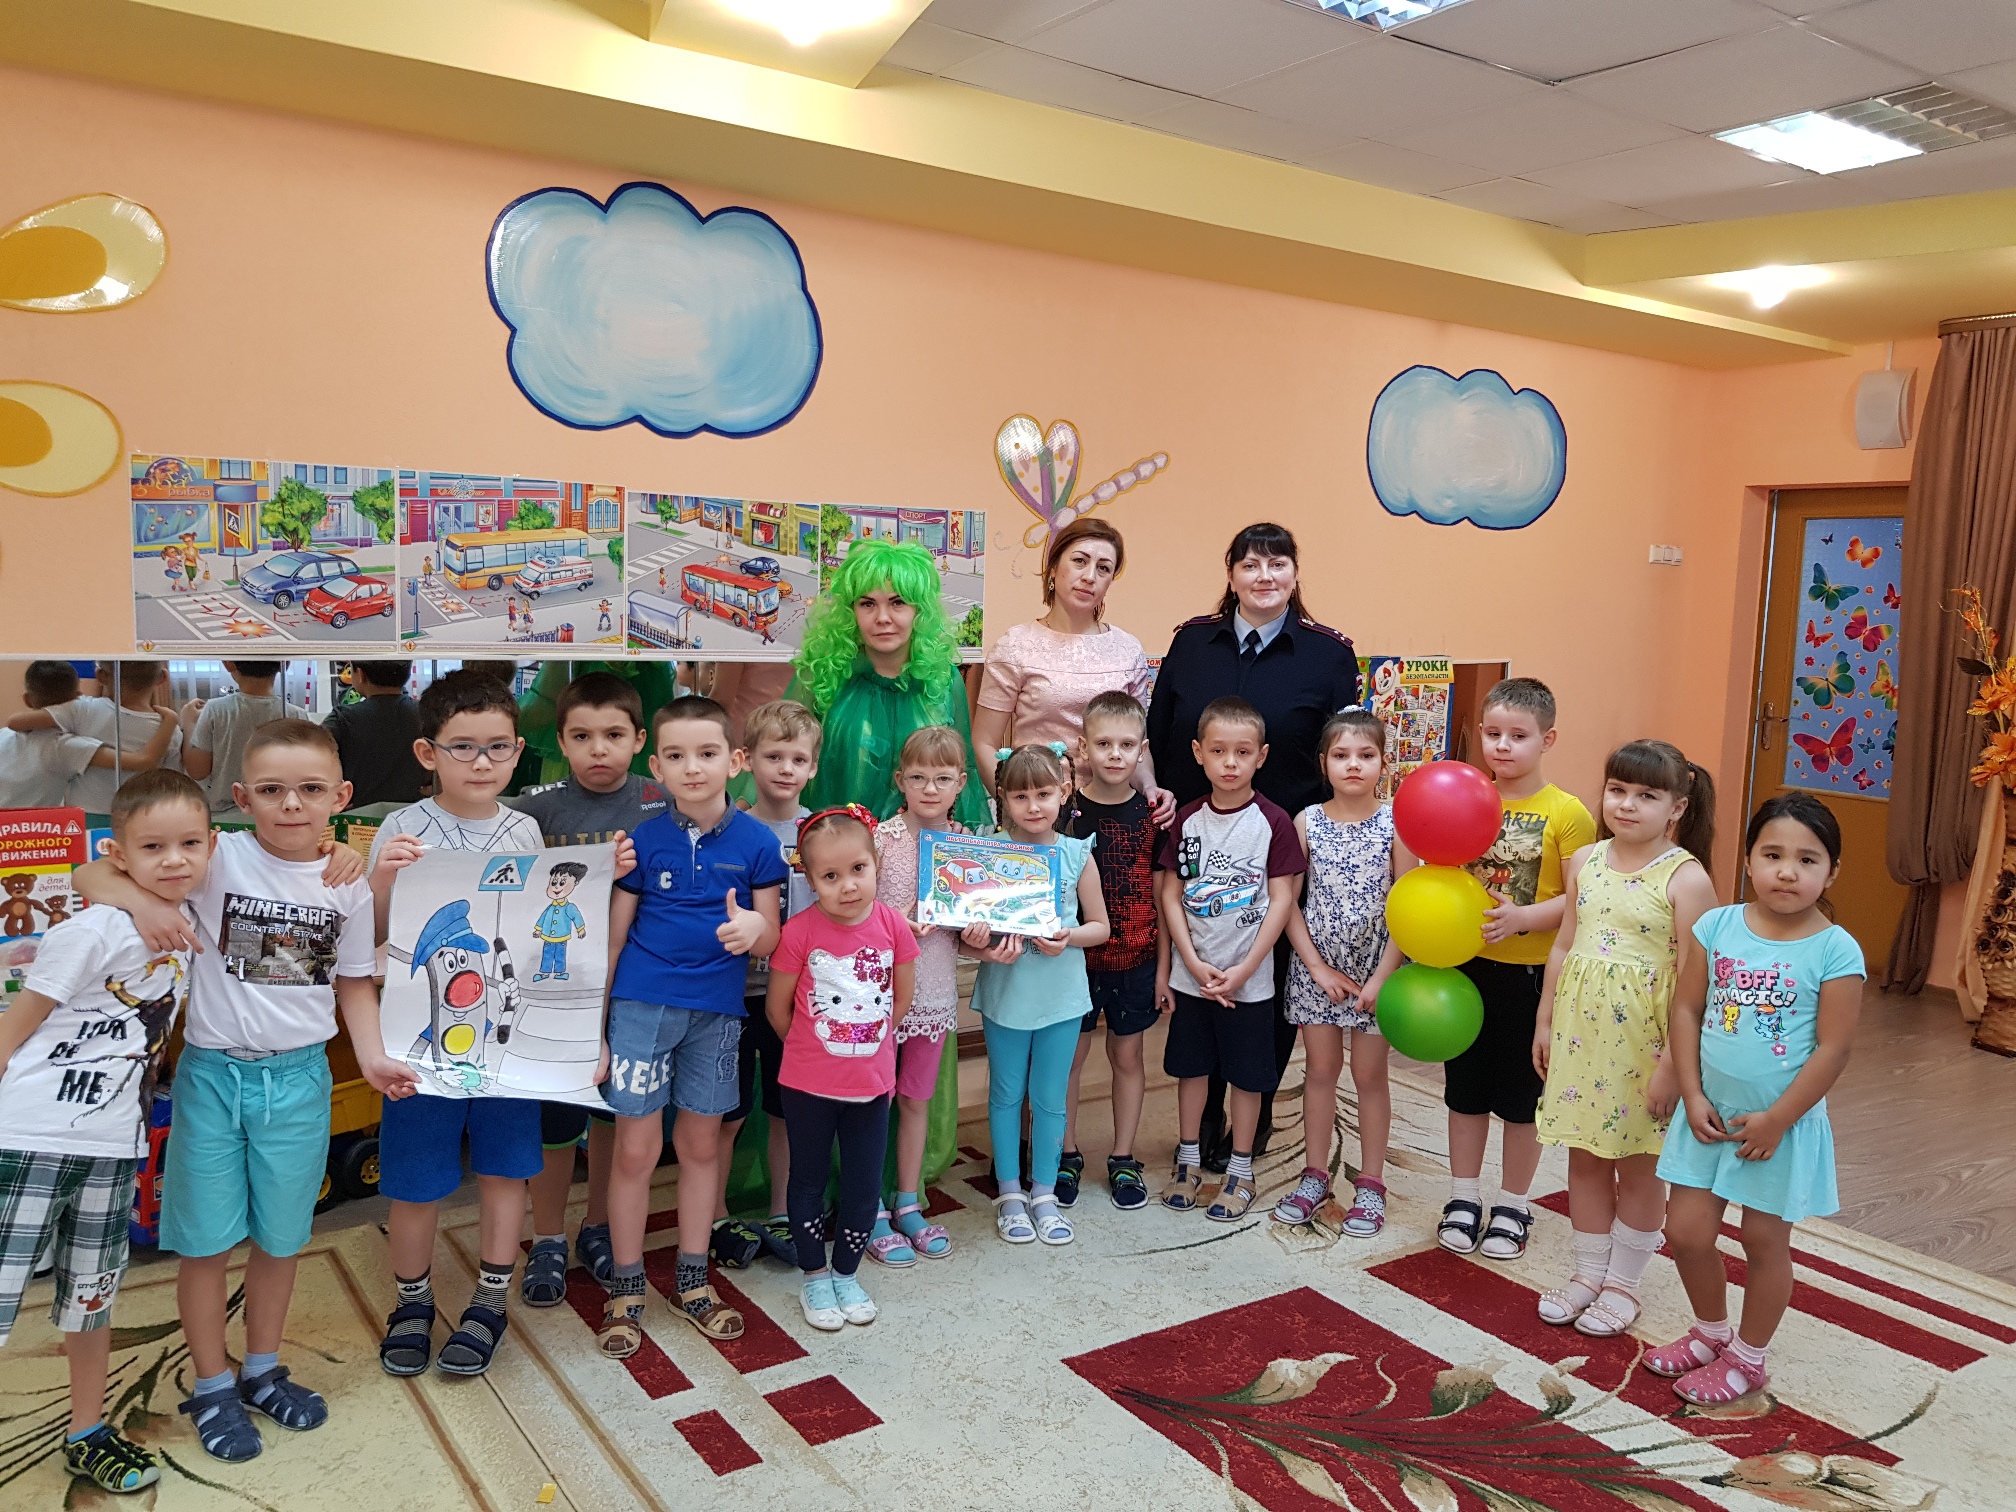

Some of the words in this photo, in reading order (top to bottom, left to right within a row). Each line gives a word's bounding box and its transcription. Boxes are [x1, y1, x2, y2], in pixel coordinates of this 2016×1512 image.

[168, 487, 212, 498] рыбка
[1406, 660, 1448, 671] УРОКИ
[531, 780, 567, 796] UFC
[1503, 809, 1549, 830] ARTH
[0, 822, 61, 837] РАВИЛА
[0, 837, 72, 851] ОРОЖНОГО
[1186, 842, 1200, 853] GO
[0, 848, 68, 863] ВИЖЕНИЯ
[1187, 852, 1199, 860] GO!
[39, 883, 70, 892] детей
[47, 876, 64, 884] для
[660, 871, 672, 889] C
[226, 896, 339, 926] MINECRAFT
[231, 921, 282, 935] COUNTER
[293, 929, 323, 941] STRIKE
[1735, 970, 1779, 990] BFF
[1713, 987, 1798, 1007] MAGIC!
[56, 1068, 108, 1105] ME
